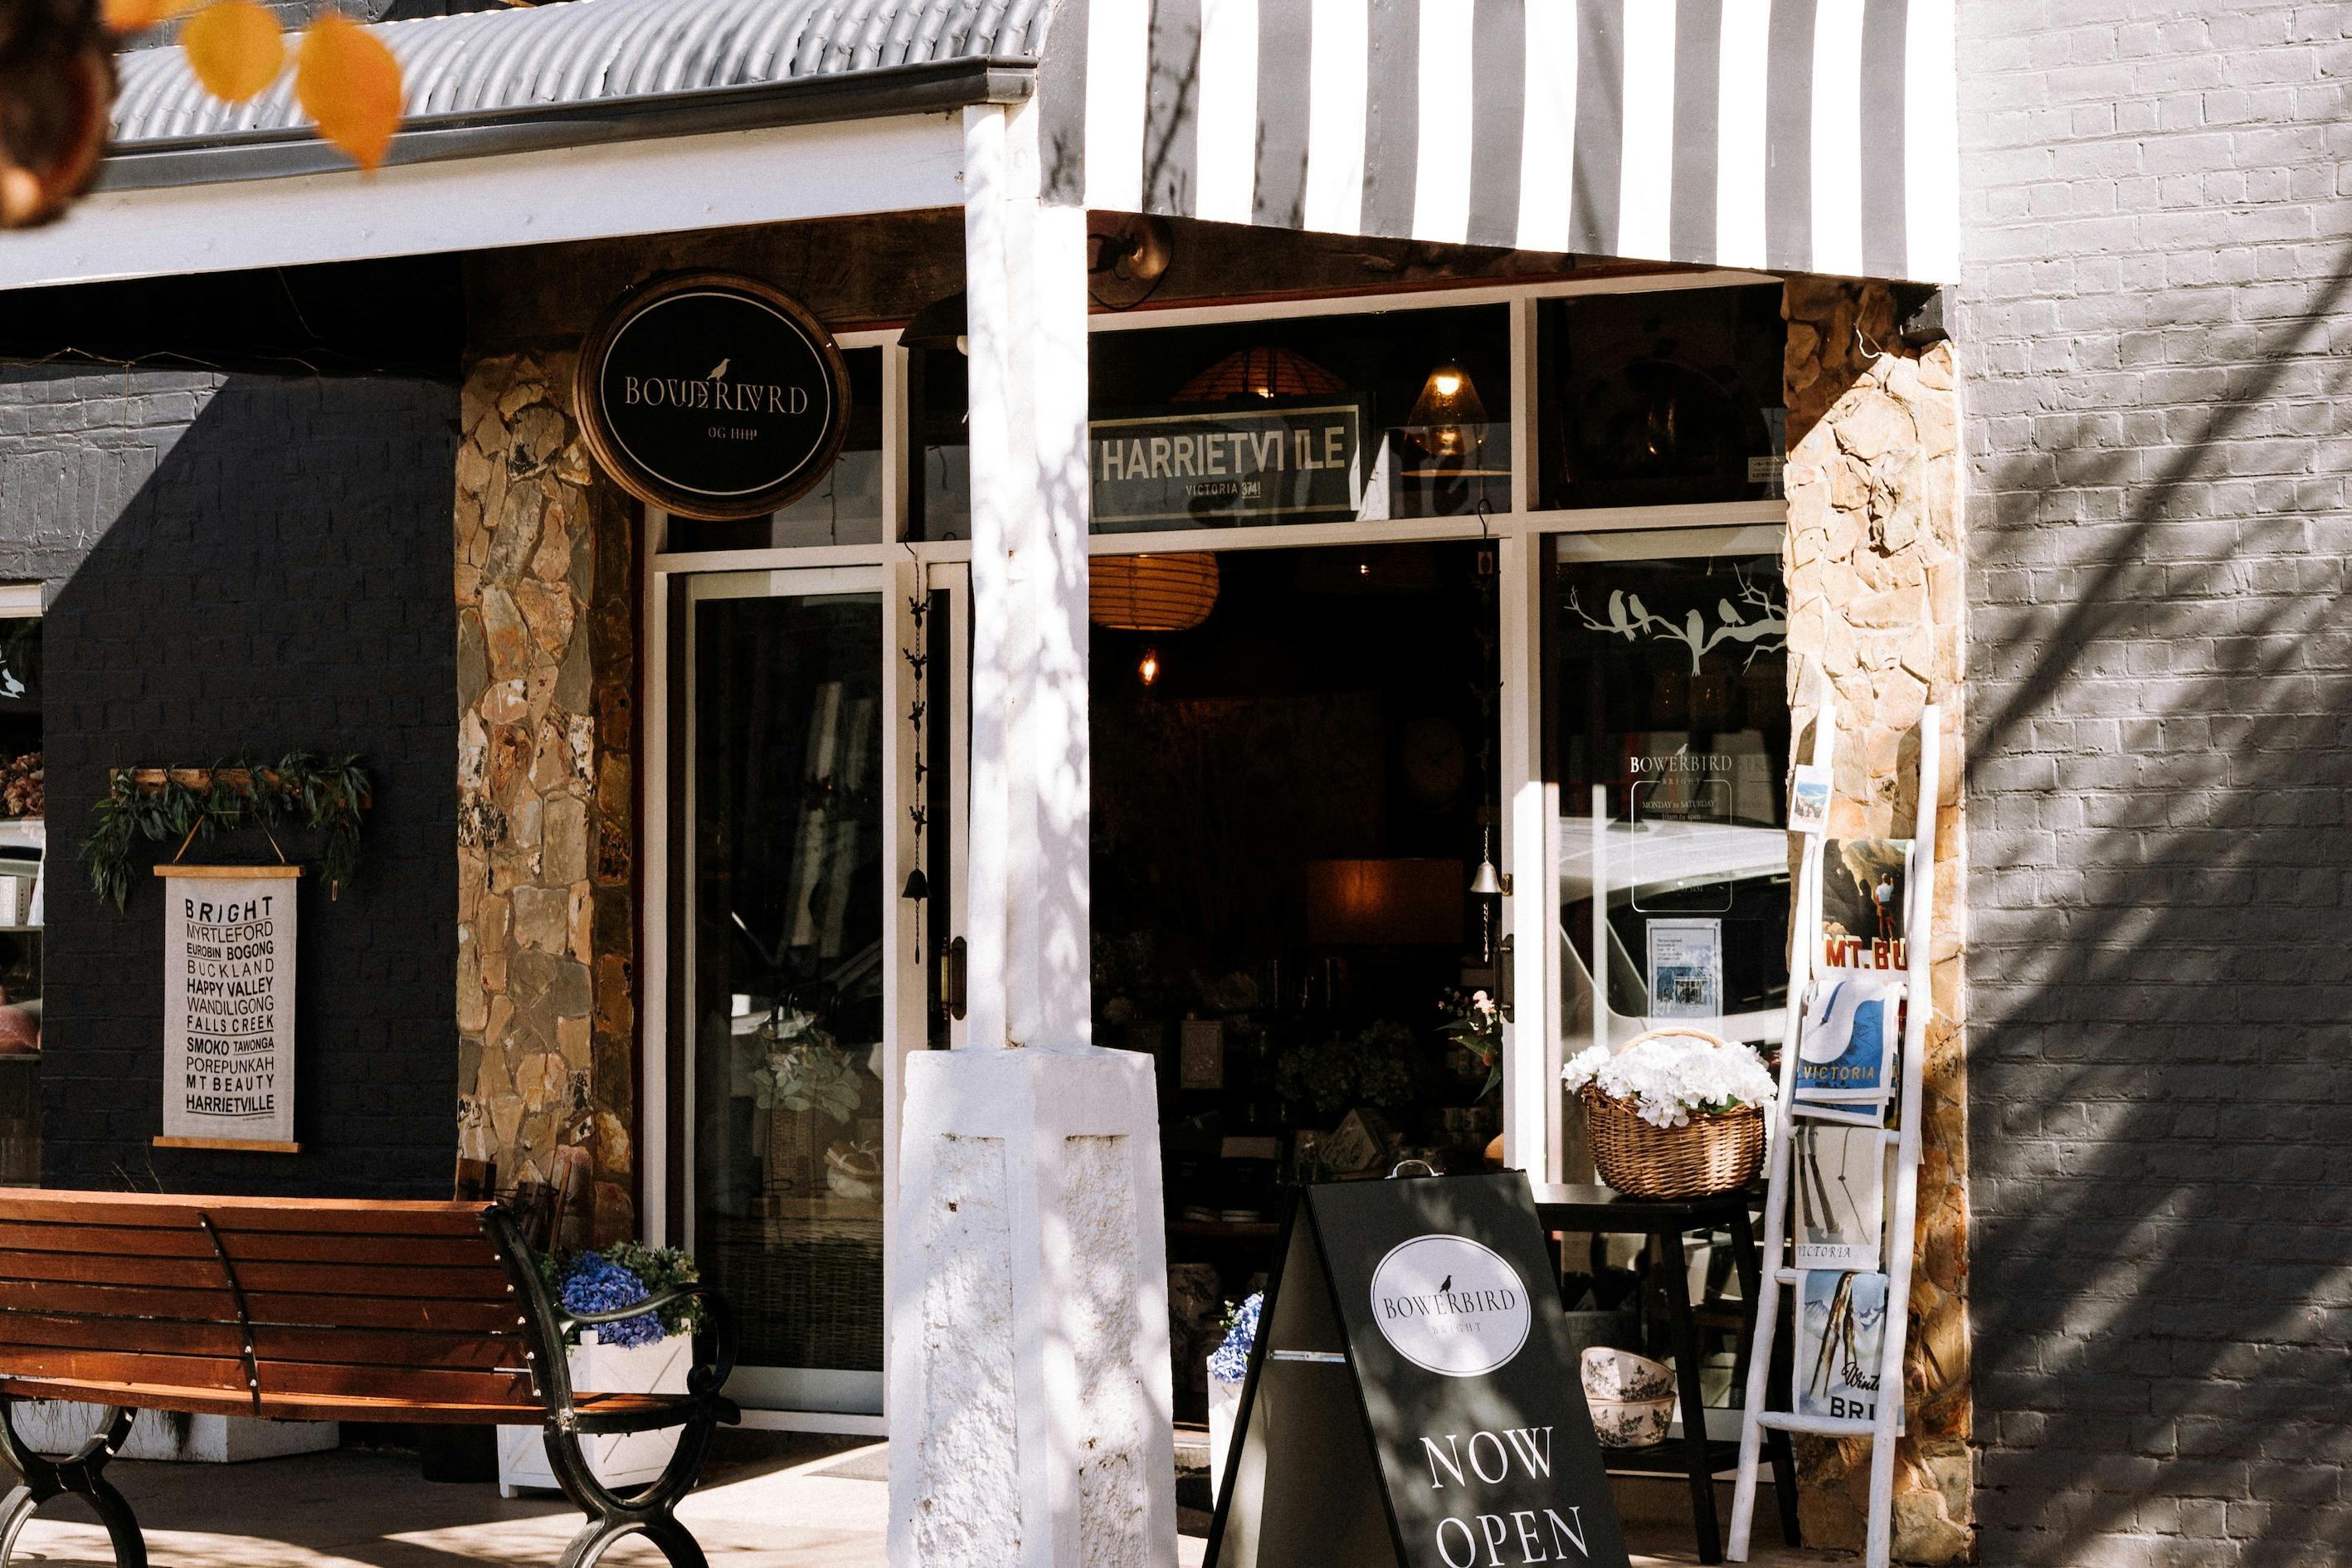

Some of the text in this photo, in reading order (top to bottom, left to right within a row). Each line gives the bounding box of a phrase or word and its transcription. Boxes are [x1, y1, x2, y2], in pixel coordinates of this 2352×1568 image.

[1186, 484, 1238, 497] VICTORIA
[1629, 754, 1732, 773] BOWERBIRD
[1642, 801, 1673, 810] MONDAY
[1680, 799, 1716, 809] SATURDAY
[185, 896, 273, 923] BRIGHT
[187, 921, 273, 943] MYRTLEFORD
[187, 940, 274, 961] EUROBIN BOGONG
[187, 958, 275, 978] BUCKLAND
[187, 976, 274, 997] HAPPY VALLEY
[187, 995, 274, 1015] WANDILIGONG
[187, 1014, 274, 1033] FALLS CREEK
[187, 1036, 275, 1056] SMOKO TAWONGA
[186, 1056, 274, 1074] POREPUNKAH
[1804, 1065, 1875, 1080] VICTORIA
[186, 1074, 274, 1092] MT BEAUTY
[186, 1093, 275, 1113] HARRIETVILLE
[1797, 1245, 1852, 1259] VICTORIA
[1382, 1288, 1516, 1321] BOWERBIRD
[1830, 1395, 1875, 1421] BRI
[1419, 1425, 1554, 1489] NOW
[1436, 1506, 1590, 1568] OPEN
